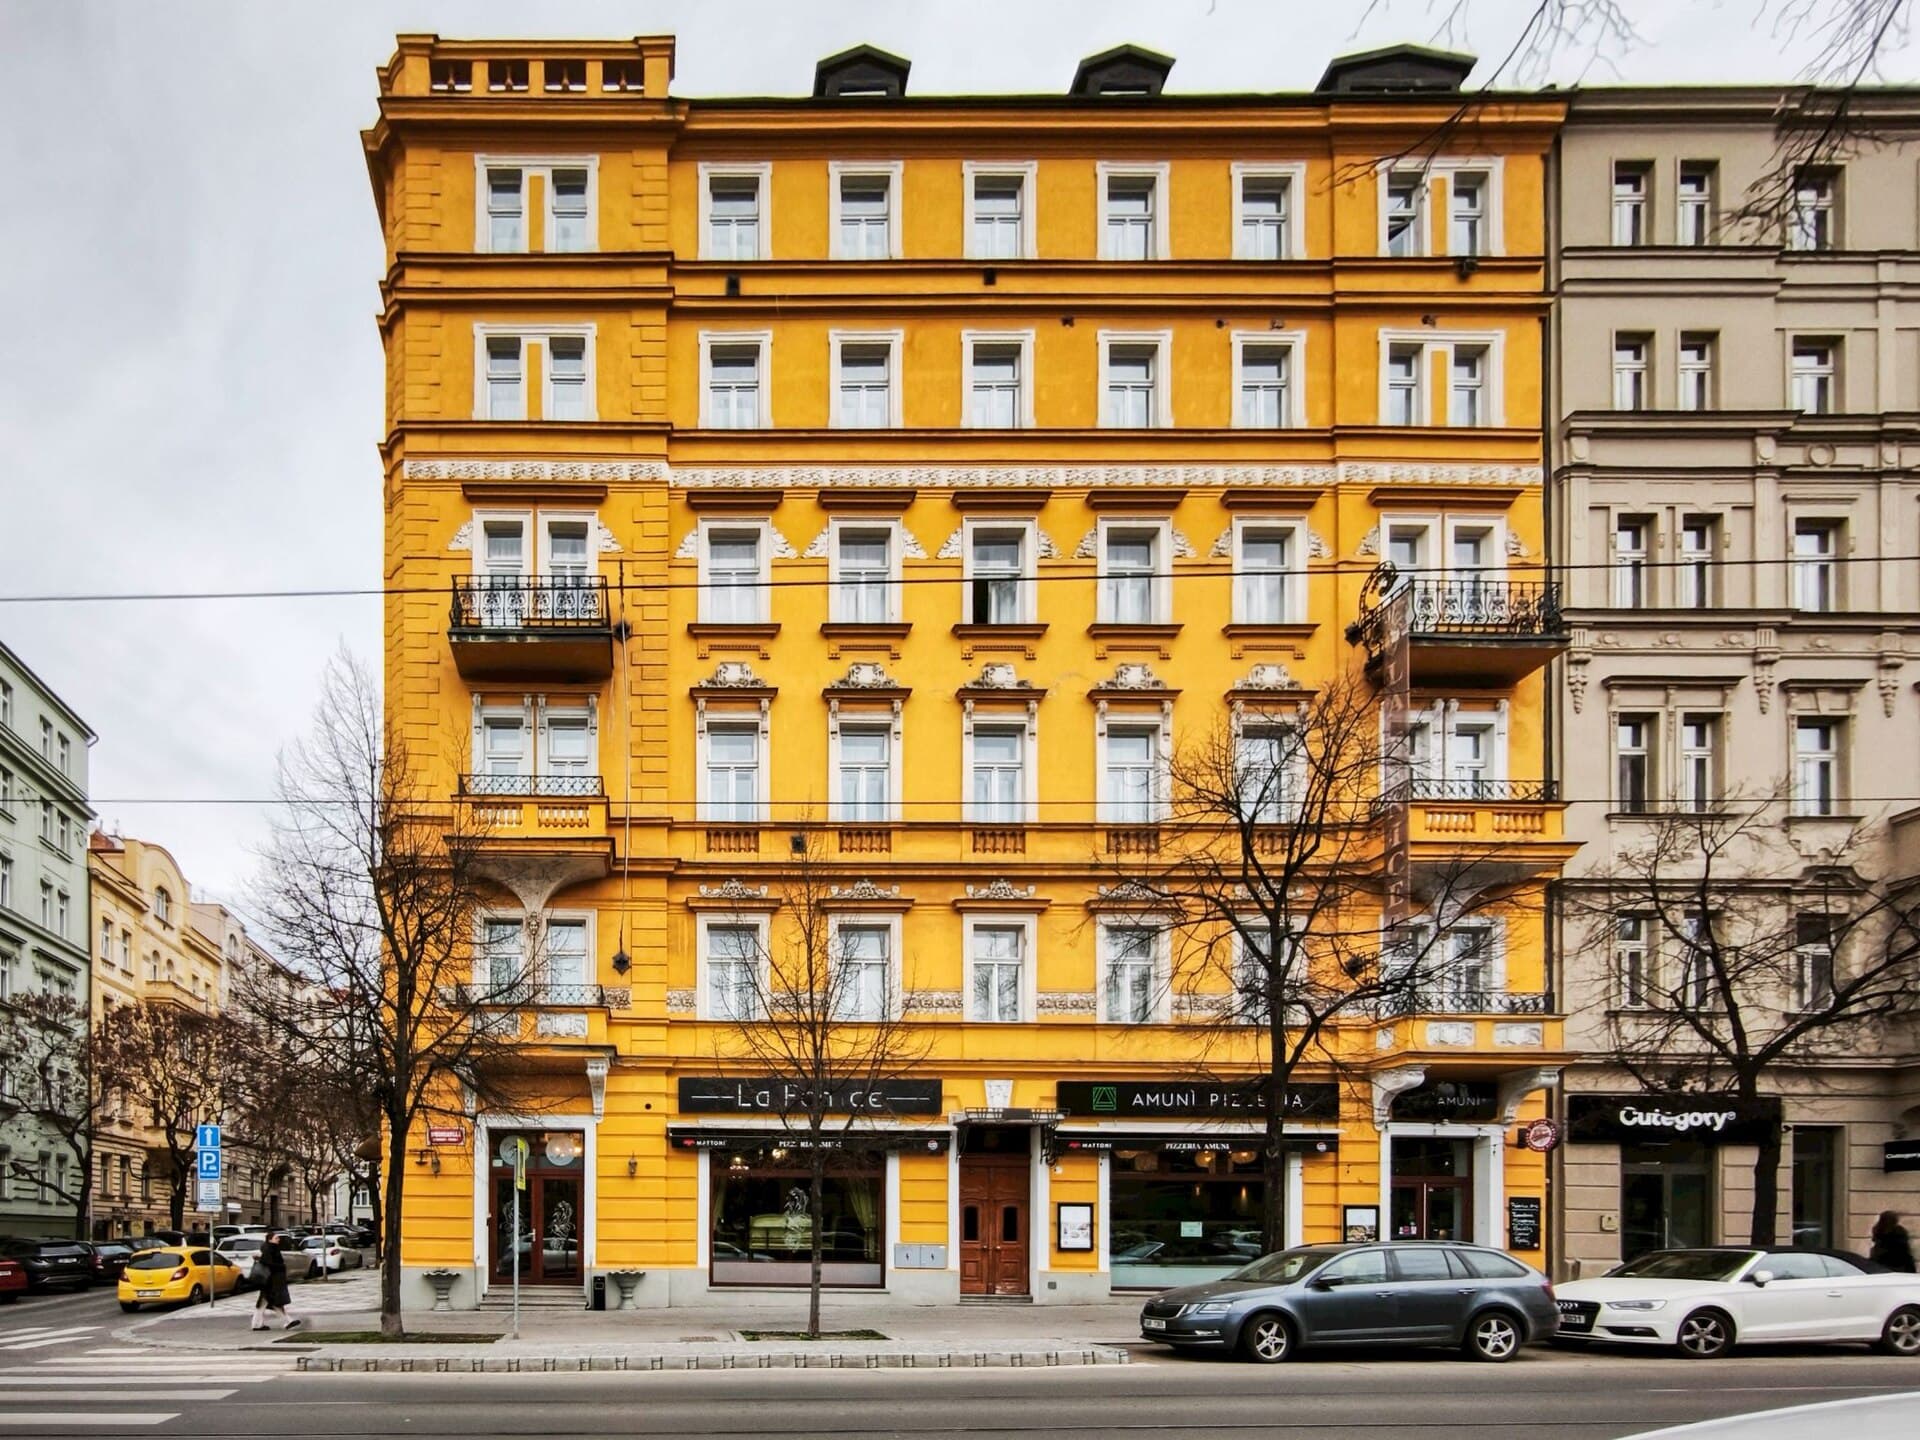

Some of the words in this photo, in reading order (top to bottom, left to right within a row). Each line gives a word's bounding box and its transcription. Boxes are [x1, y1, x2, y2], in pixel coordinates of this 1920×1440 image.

[738, 1084, 769, 1107] La
[784, 1084, 883, 1107] Fence
[1132, 1089, 1195, 1107] AMUNÌ
[1210, 1092, 1303, 1108] PIZEIA
[1619, 1106, 1730, 1131] Cutegory
[202, 1152, 217, 1171] P
